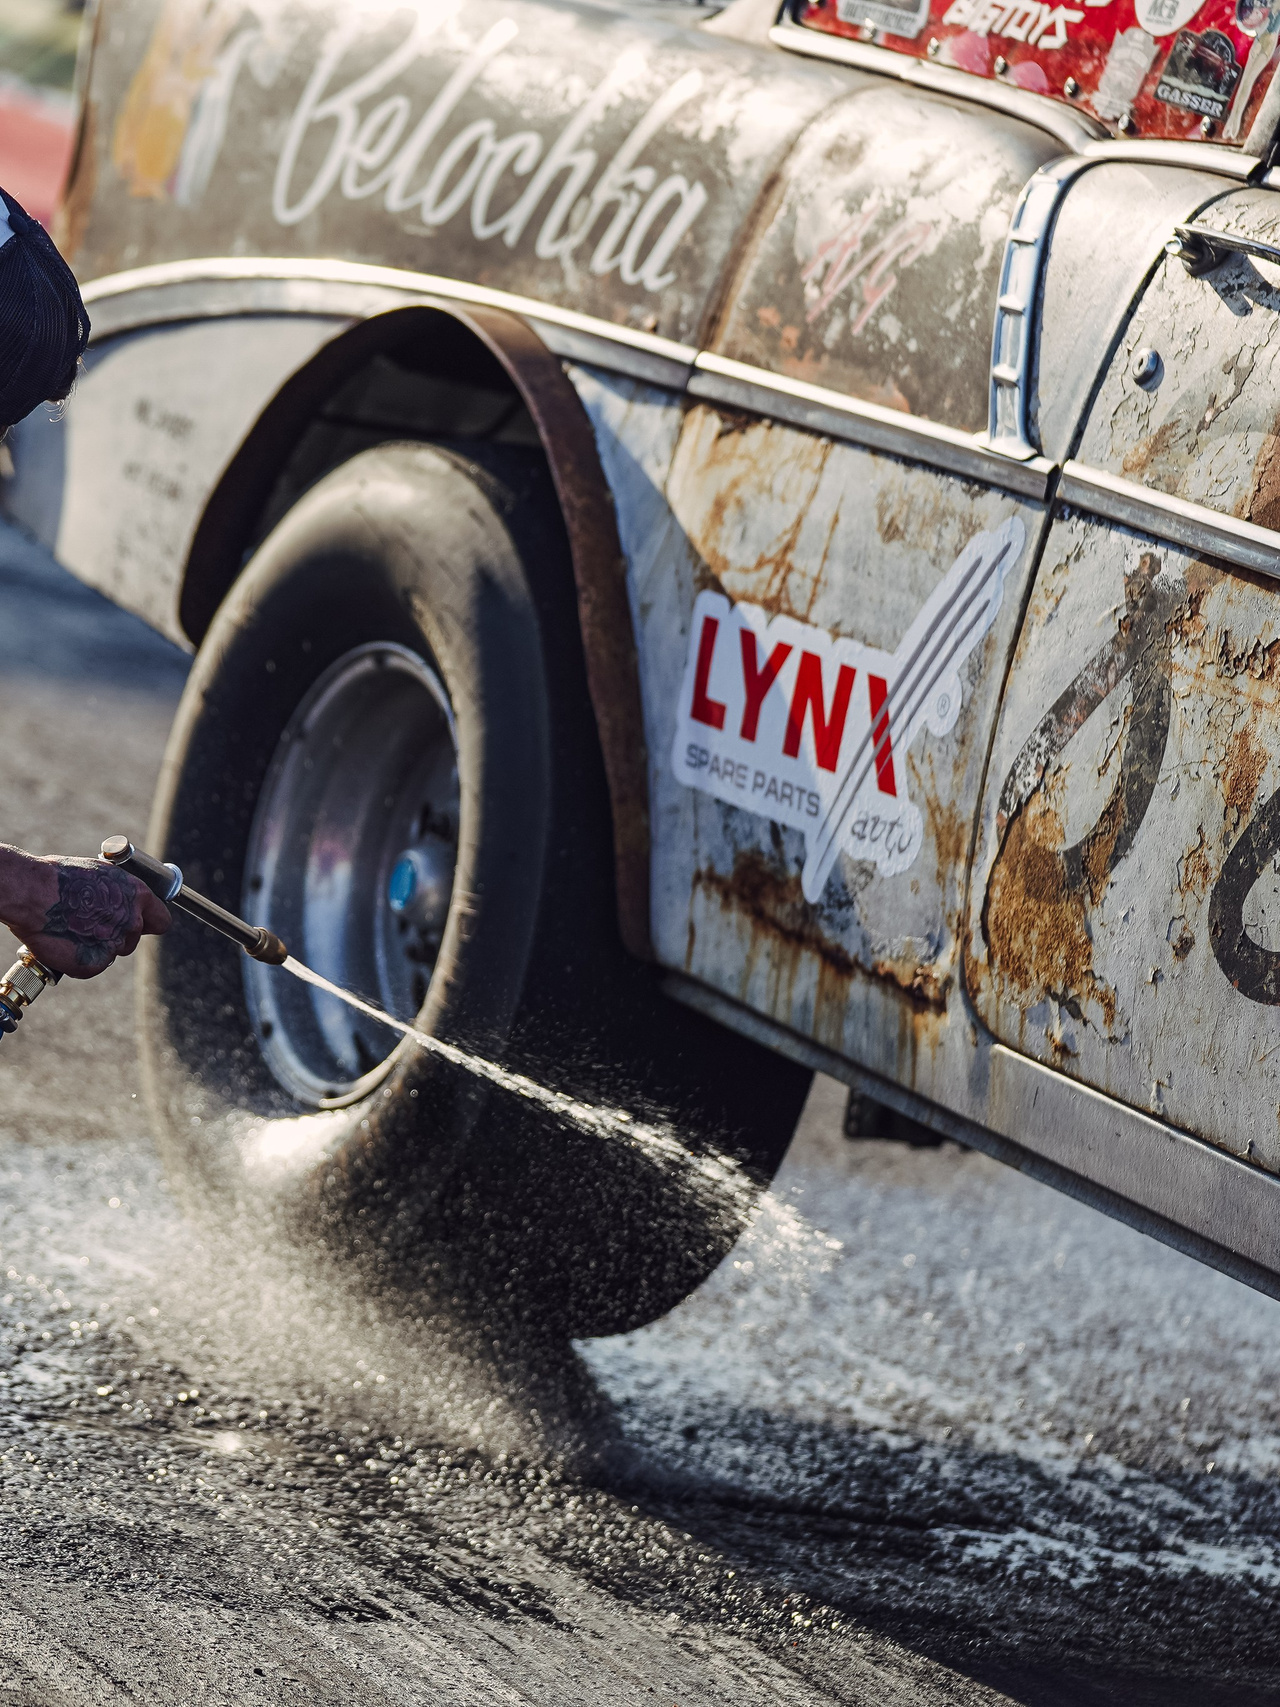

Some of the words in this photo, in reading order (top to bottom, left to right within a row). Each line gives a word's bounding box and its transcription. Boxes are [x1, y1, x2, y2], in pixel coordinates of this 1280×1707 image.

[1156, 83, 1224, 118] GASSER
[273, 10, 706, 291] Belochka
[690, 615, 899, 798] LYNX
[685, 743, 747, 789] SPARE
[751, 772, 821, 818] PARTS
[851, 812, 912, 856] auto
